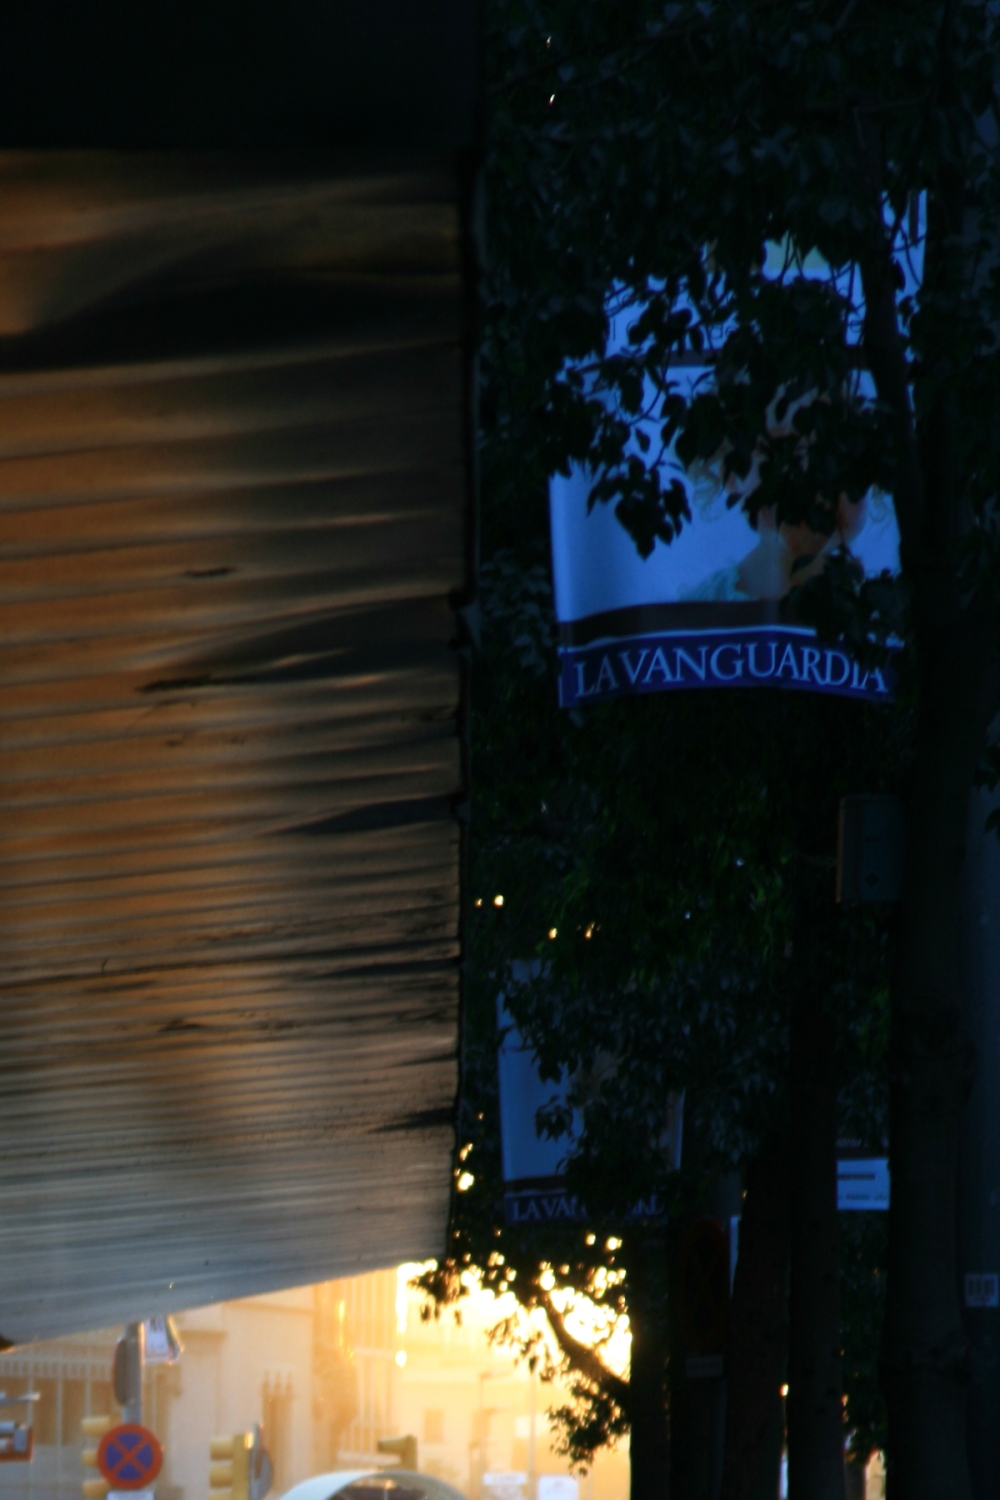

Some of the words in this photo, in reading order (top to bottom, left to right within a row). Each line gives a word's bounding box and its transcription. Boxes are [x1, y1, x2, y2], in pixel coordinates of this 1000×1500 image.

[573, 653, 620, 698] LA
[618, 641, 889, 694] VANGUARDIA
[512, 1198, 542, 1222] LA
